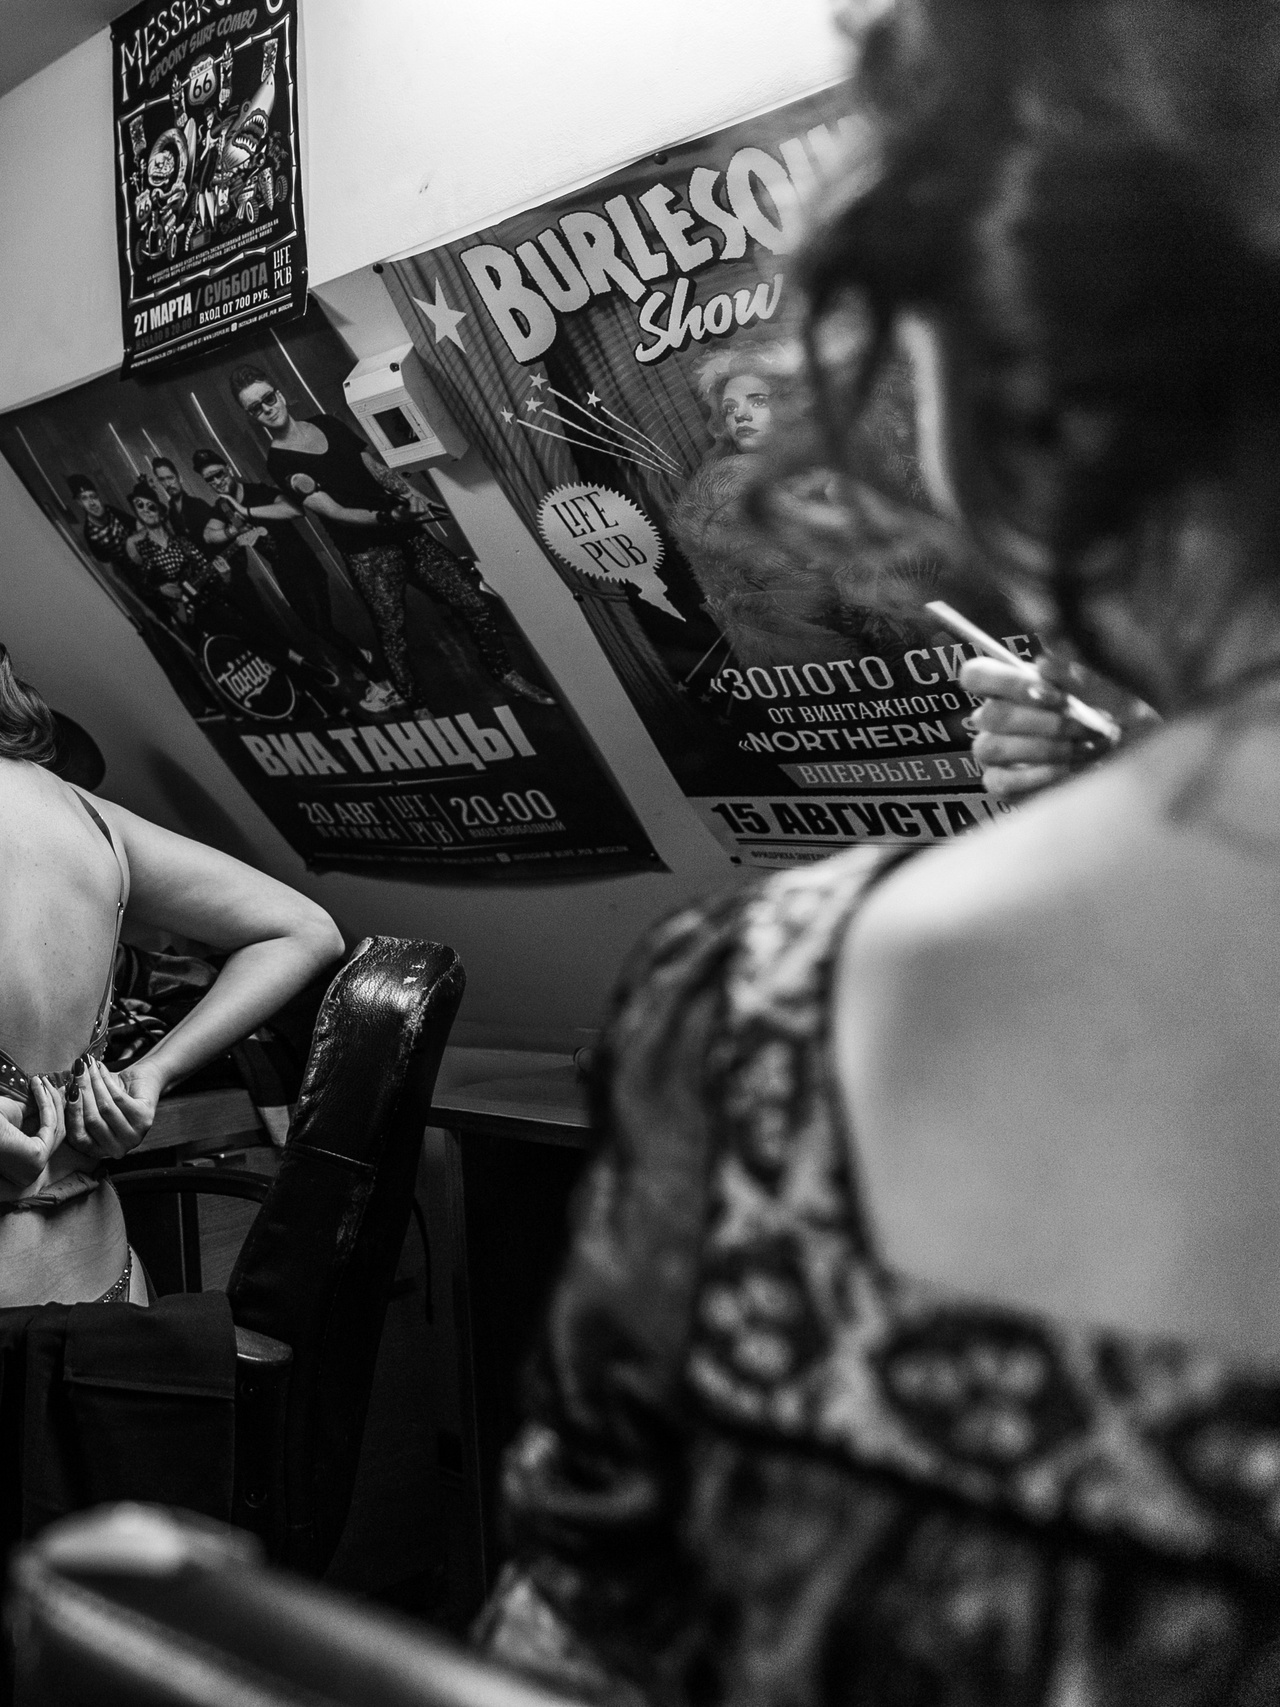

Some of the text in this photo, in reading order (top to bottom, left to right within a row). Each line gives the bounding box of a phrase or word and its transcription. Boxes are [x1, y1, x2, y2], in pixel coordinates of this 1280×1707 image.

[149, 8, 257, 88] SPOOKY SURF COMBO
[193, 72, 212, 99] 66
[273, 245, 292, 269] LIFE
[274, 266, 293, 289] PUB
[134, 311, 148, 337] 27
[150, 292, 192, 330] МАРТА
[204, 261, 268, 307] СУББОТА
[199, 306, 221, 324] ВХОД
[222, 301, 234, 315] ОТ
[235, 294, 250, 311] 700
[252, 288, 270, 304] РУБ.
[634, 273, 785, 363] Show
[550, 491, 619, 538] LIFE
[580, 533, 648, 574] PUB
[709, 655, 895, 701] «ЗОЛОТО
[767, 705, 794, 724] ОТ
[801, 690, 961, 723] ВИНТАЖНОГО
[240, 705, 538, 776] ВИА ТАНЦЫ
[738, 719, 951, 753] «NORTHERN
[796, 757, 931, 785] ВПЕРВЫЕ
[298, 801, 335, 825] 20
[389, 794, 437, 819] LIFE
[449, 789, 557, 826] 20:00
[711, 801, 981, 838] 15 АВГУСТА
[408, 820, 454, 844] PUB
